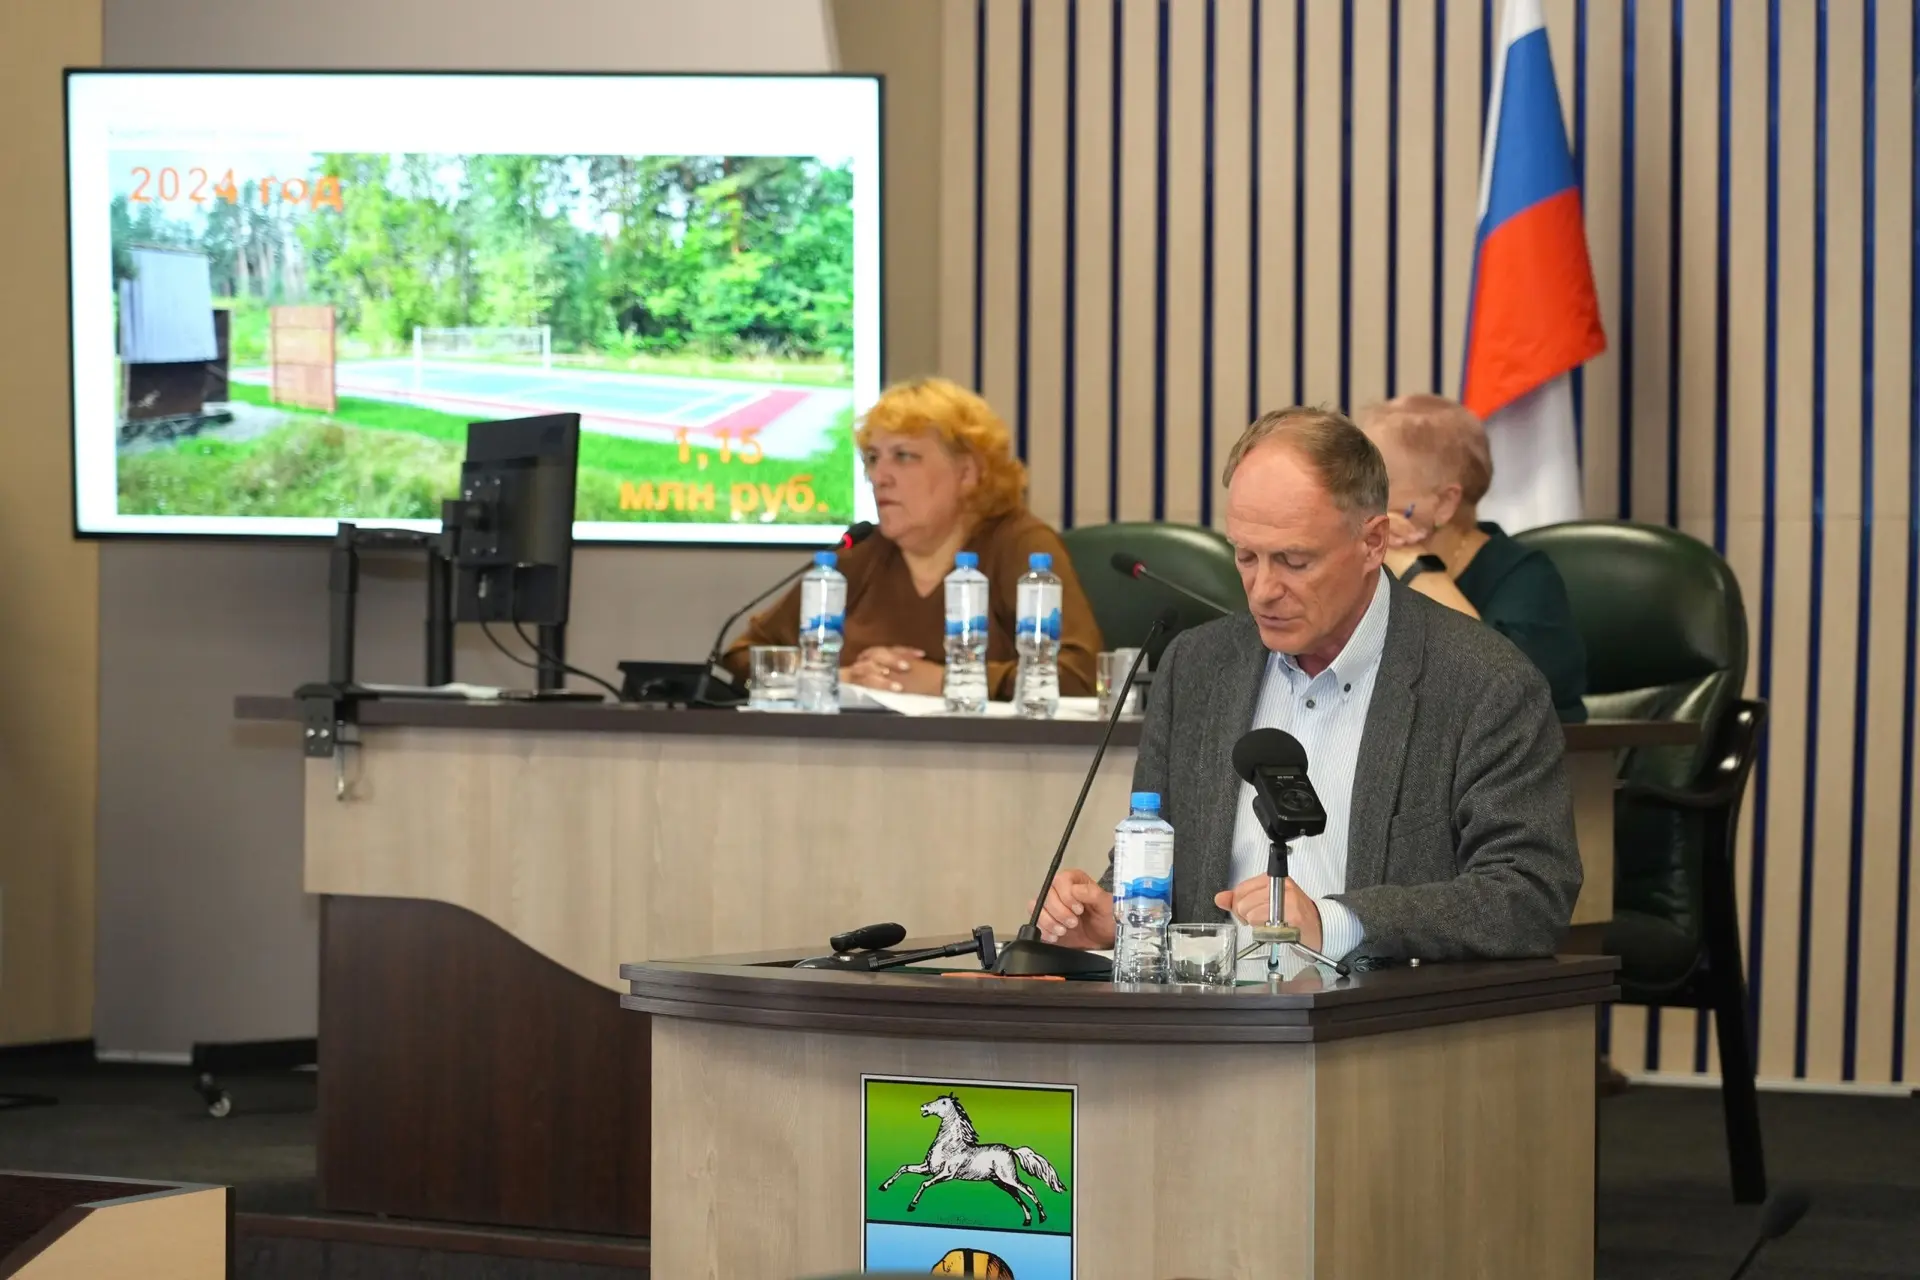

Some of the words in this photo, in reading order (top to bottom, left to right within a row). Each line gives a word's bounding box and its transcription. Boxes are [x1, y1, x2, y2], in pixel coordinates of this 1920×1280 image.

[129, 166, 238, 205] 2024
[260, 174, 344, 212] год
[674, 427, 763, 471] 1,15
[619, 480, 715, 511] млн
[730, 474, 829, 522] руб.
